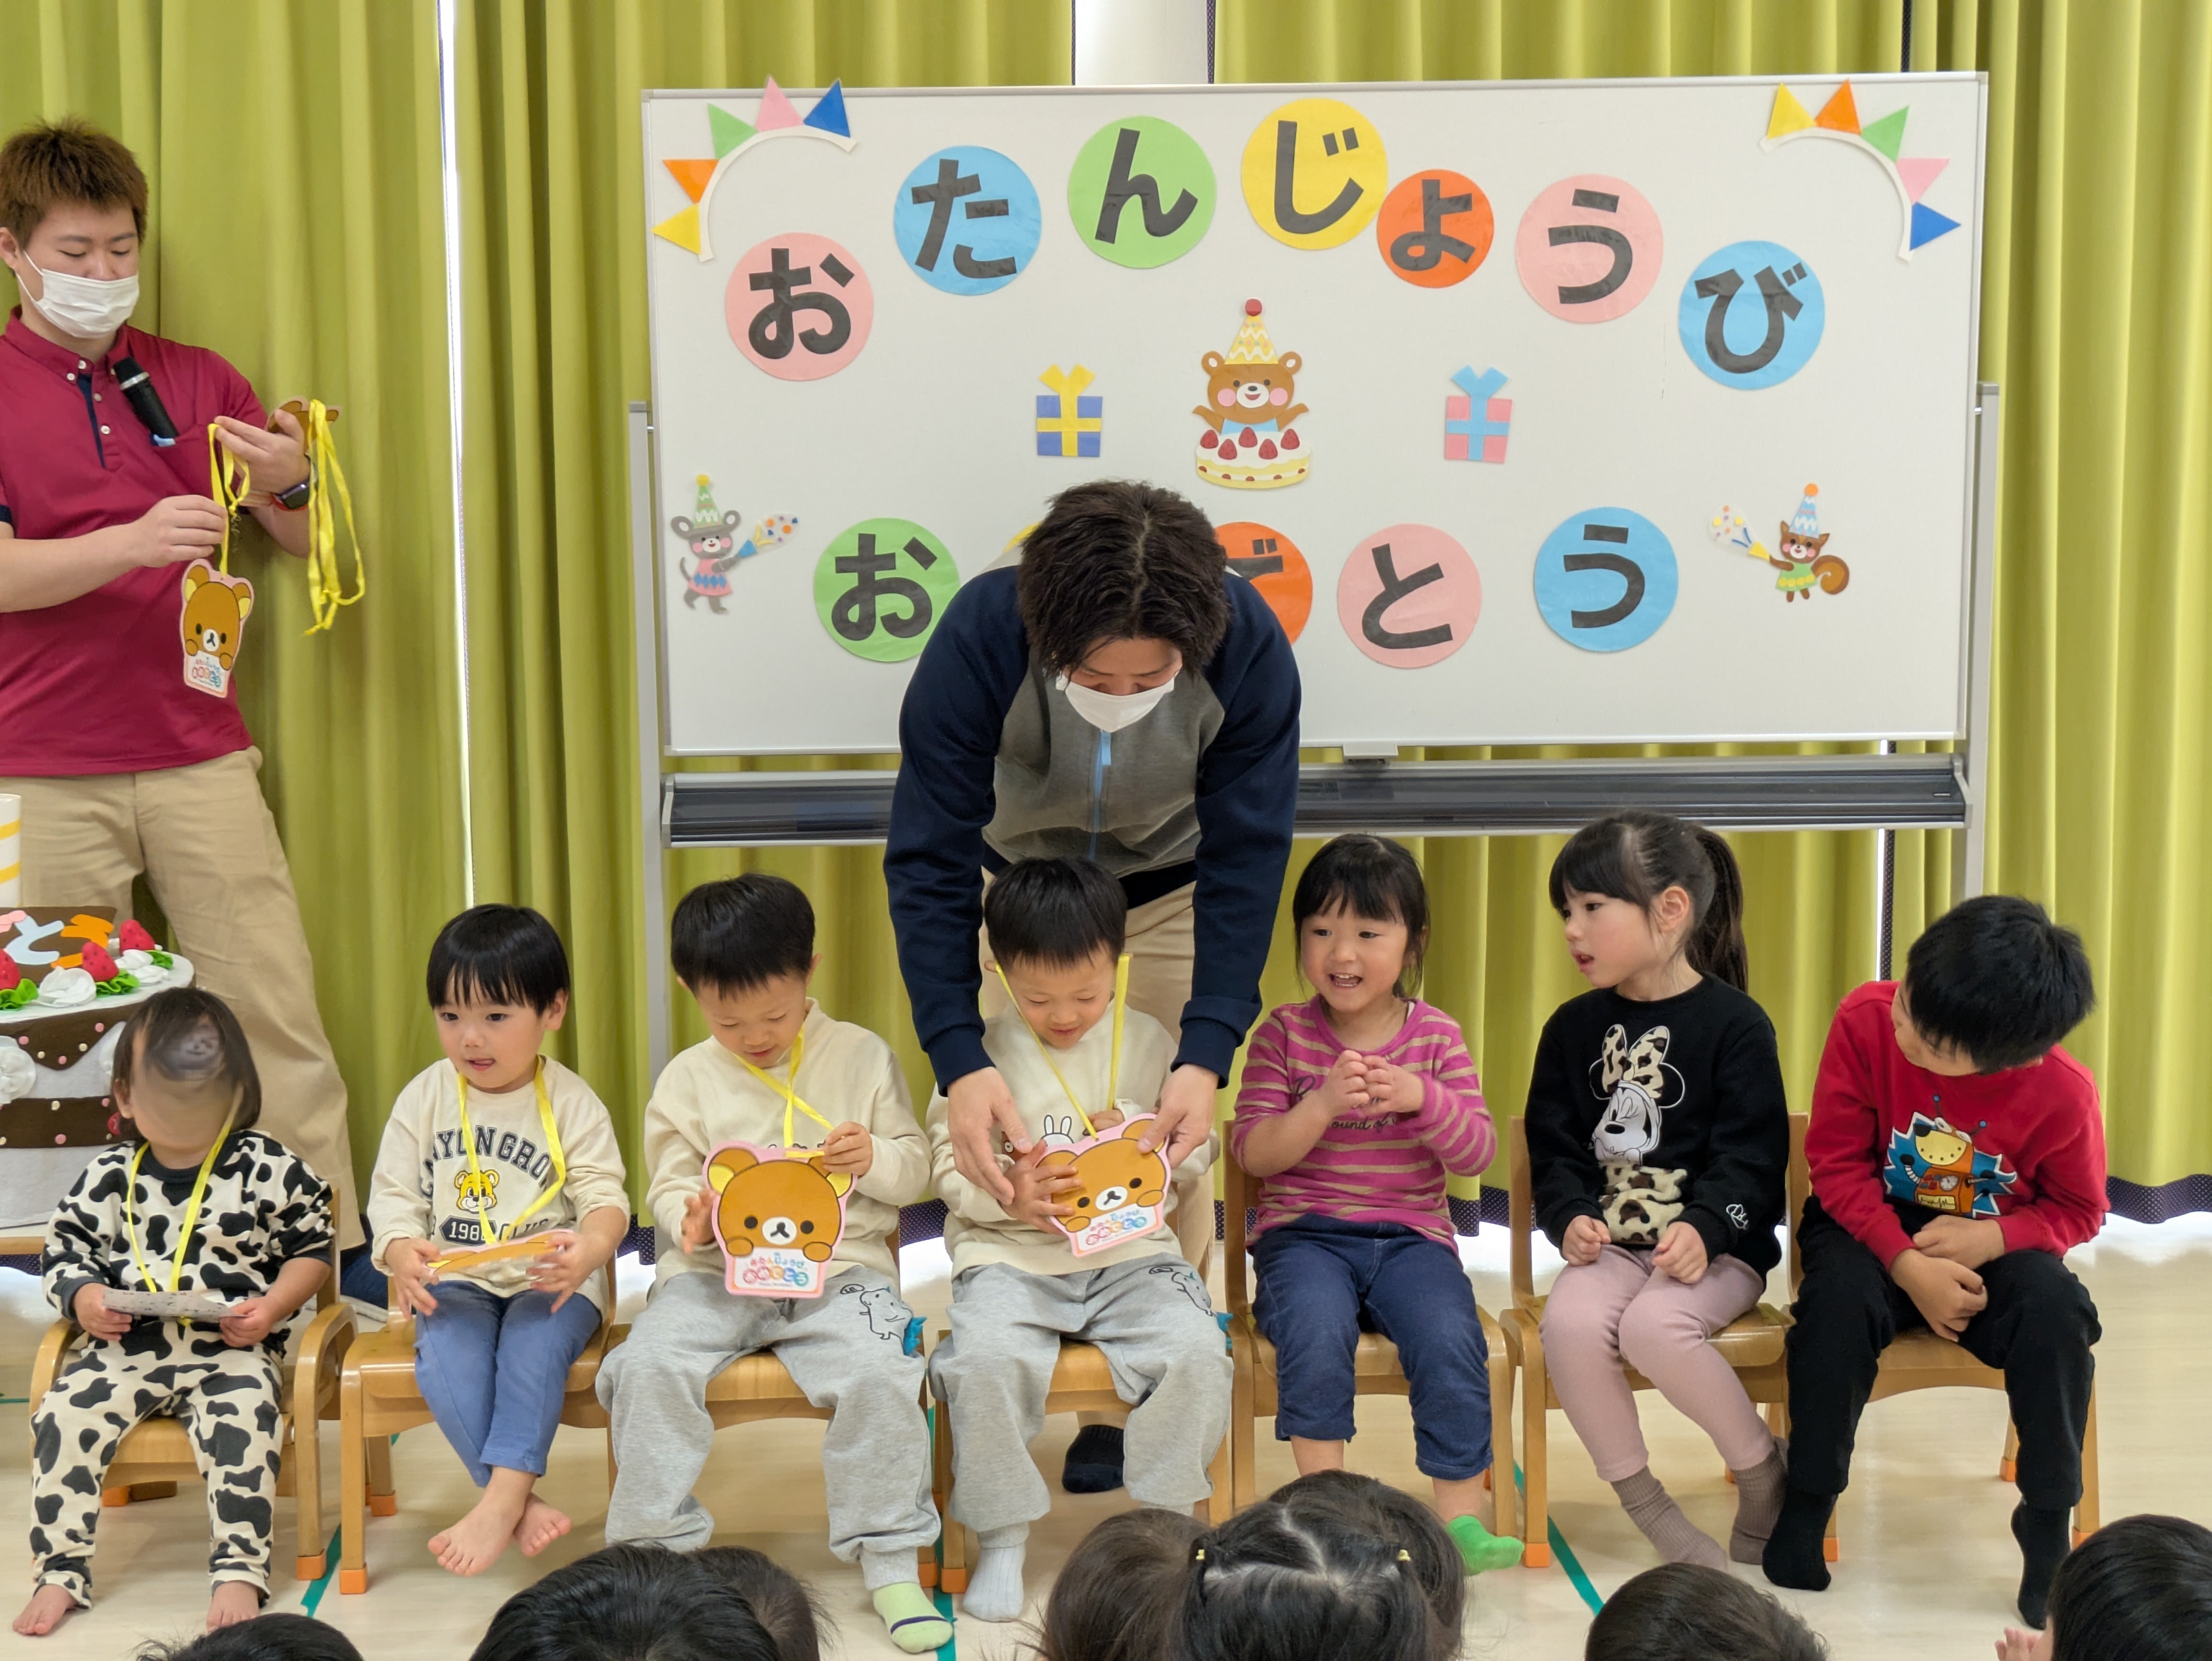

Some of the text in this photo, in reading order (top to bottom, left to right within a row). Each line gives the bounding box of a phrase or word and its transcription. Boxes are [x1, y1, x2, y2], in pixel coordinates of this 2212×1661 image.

[749, 120, 1808, 374] おたんじょうび
[1331, 1116, 1371, 1130] ound
